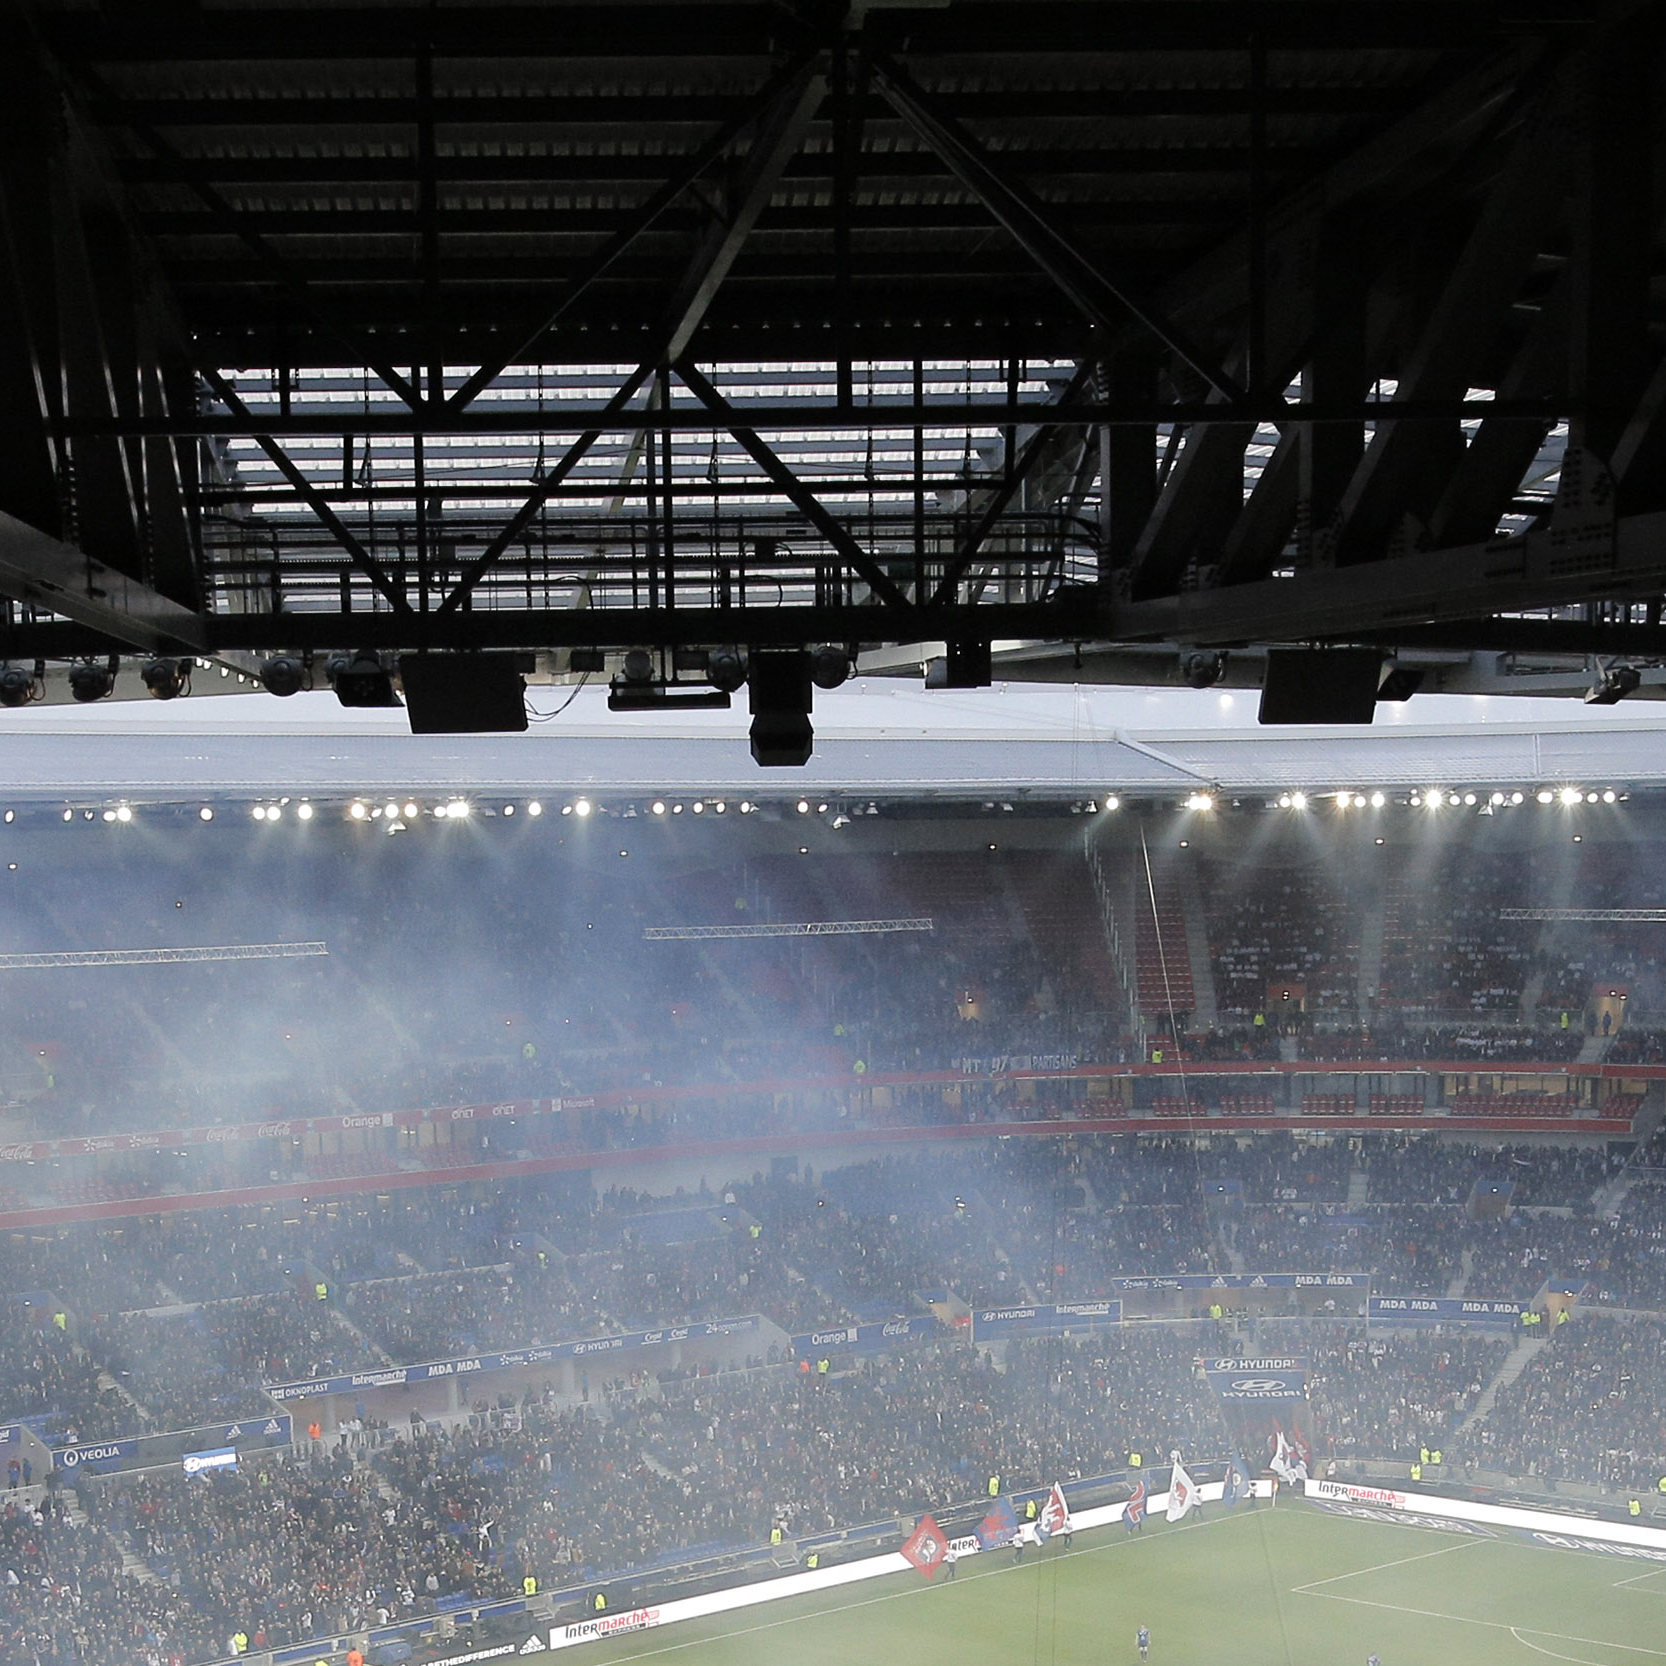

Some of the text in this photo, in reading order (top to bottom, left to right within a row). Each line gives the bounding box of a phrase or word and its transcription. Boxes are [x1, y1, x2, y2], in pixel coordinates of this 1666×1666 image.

[1032, 1055, 1077, 1070] PARTISANS
[342, 1114, 381, 1128] Orange
[1295, 1276, 1353, 1285] MDA MDA
[1379, 1300, 1438, 1310] MDA MDA
[1462, 1302, 1520, 1314] MDA MDA
[997, 1309, 1035, 1320] HYUNDAI
[812, 1331, 847, 1345] Orange
[428, 1359, 481, 1376] MDA MDA
[285, 1383, 329, 1397] OKNOPLAST
[1222, 1390, 1301, 1398] HYUNDAI
[79, 1446, 120, 1461] VEOLIA
[1318, 1481, 1396, 1502] Intermarché
[565, 1608, 649, 1639] Intermarché
